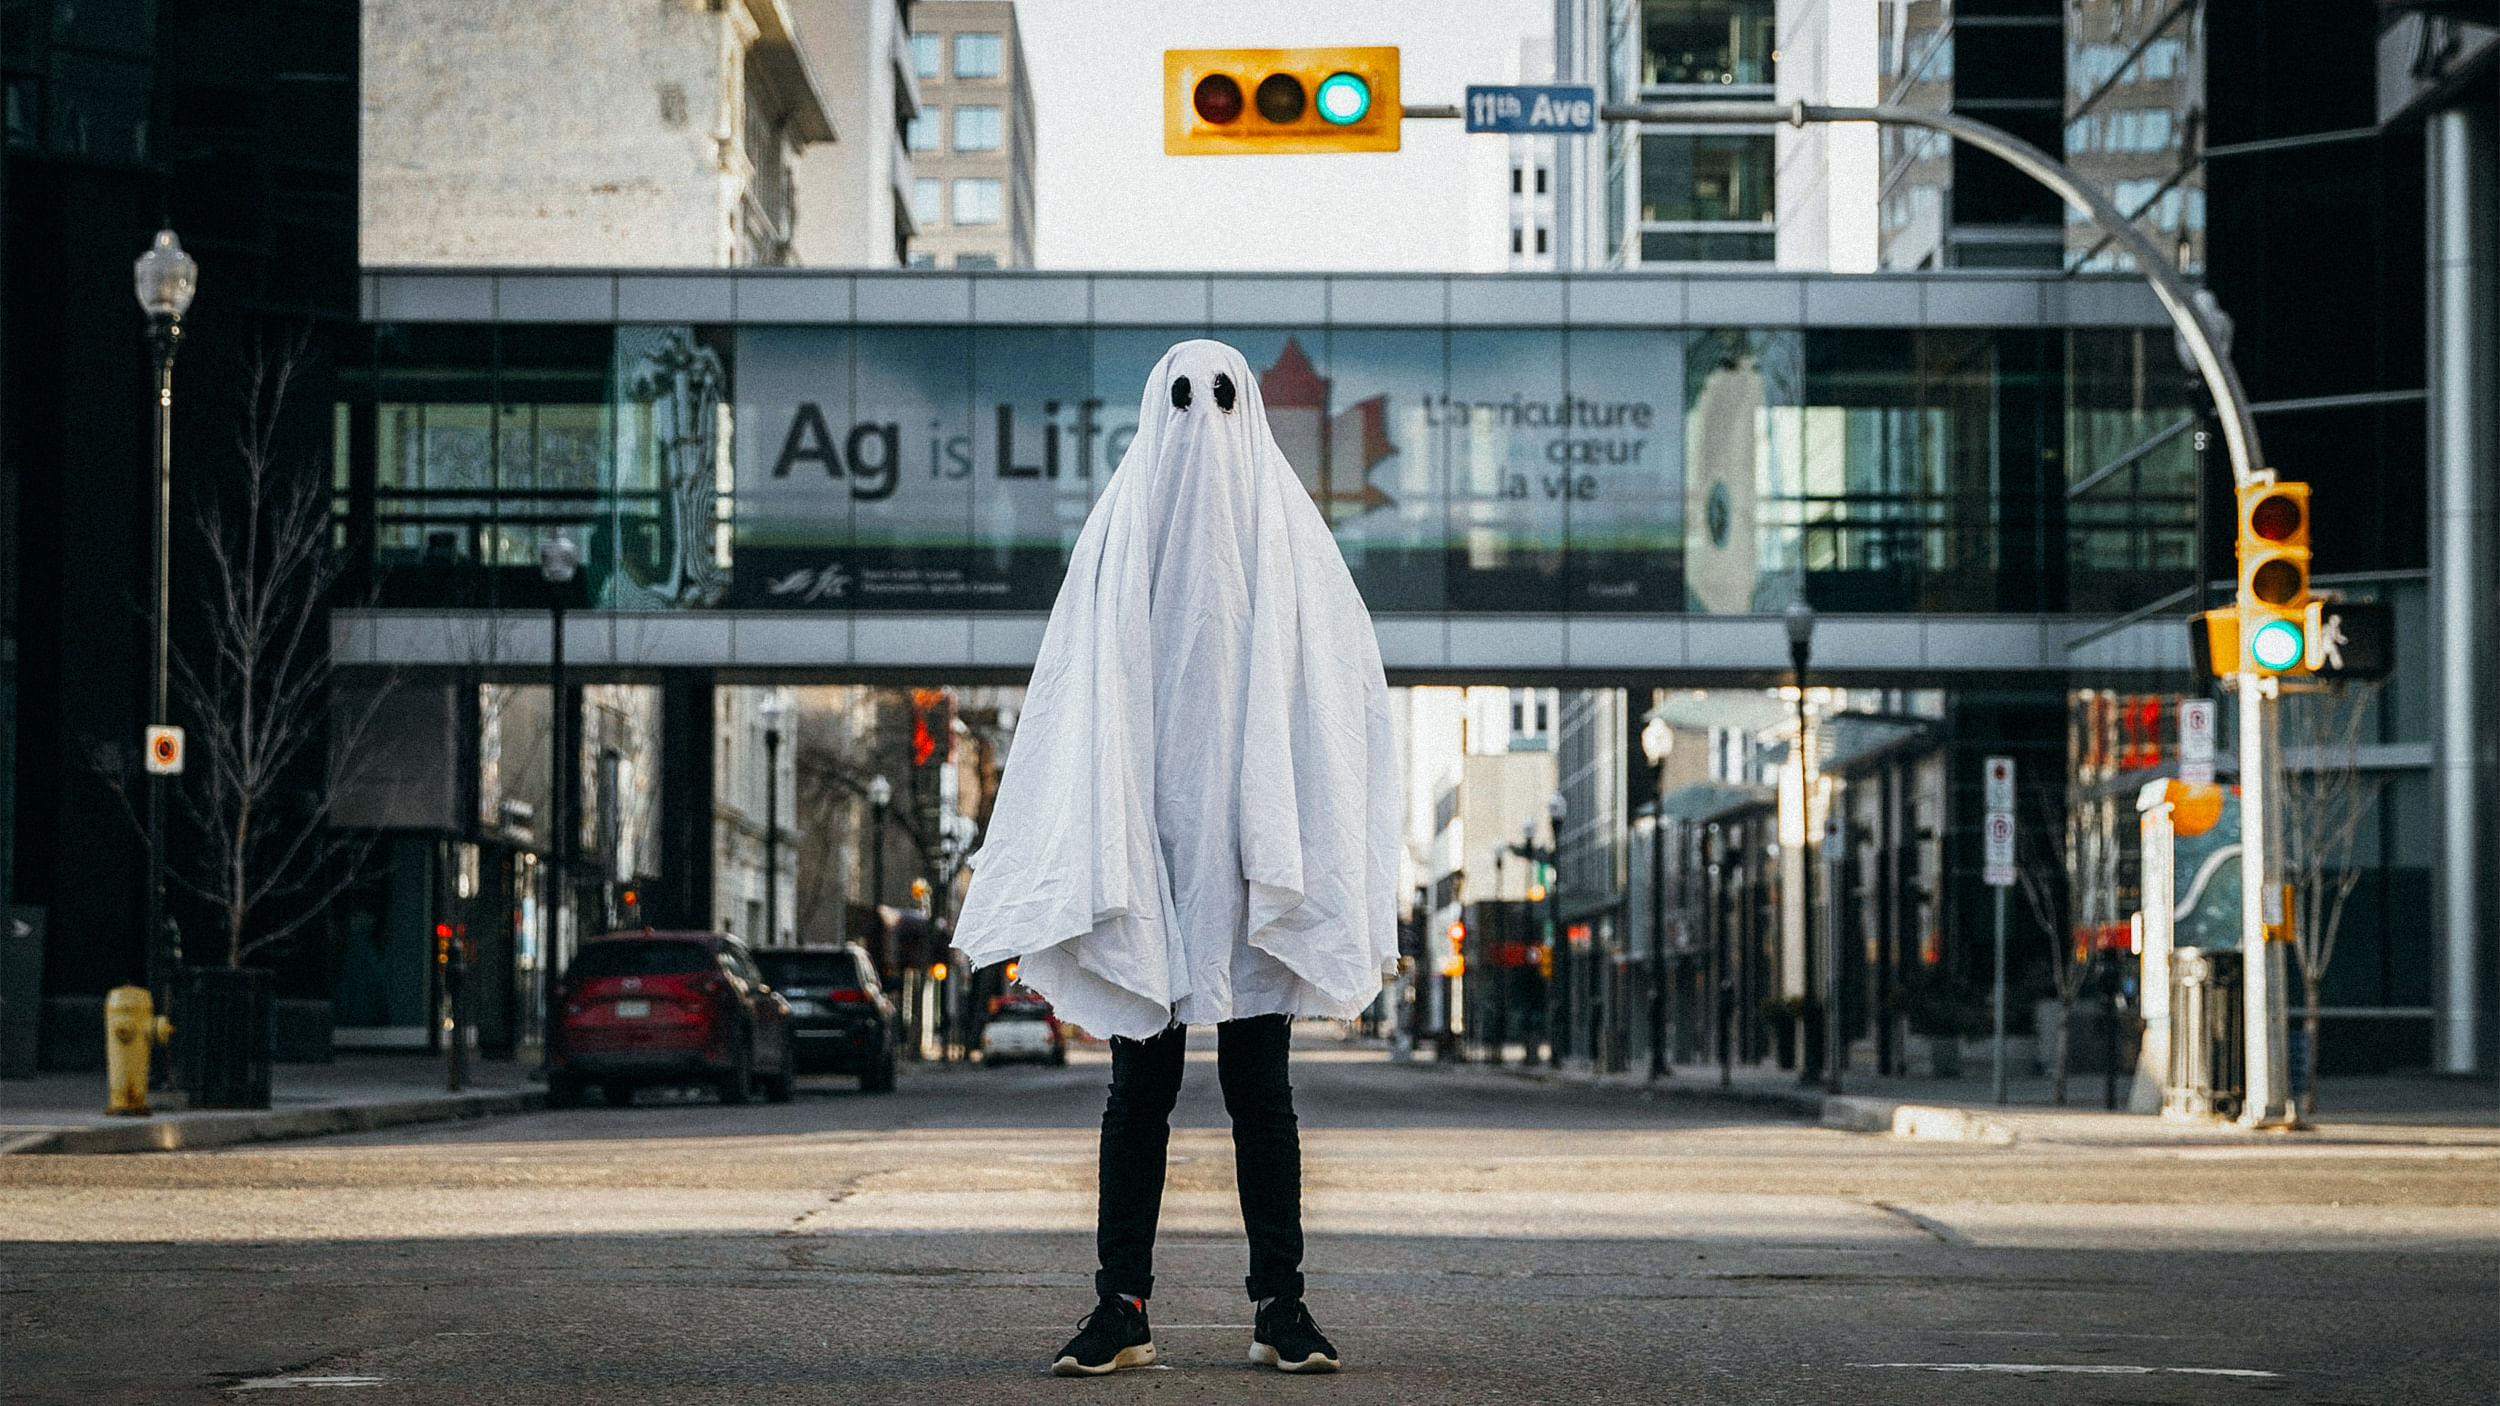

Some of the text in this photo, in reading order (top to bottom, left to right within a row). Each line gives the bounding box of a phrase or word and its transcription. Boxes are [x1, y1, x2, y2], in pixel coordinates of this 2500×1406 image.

[1470, 92, 1591, 127] 11th Ave
[772, 401, 899, 502] Ag
[929, 418, 972, 480] is
[1499, 466, 1599, 500] la vie
